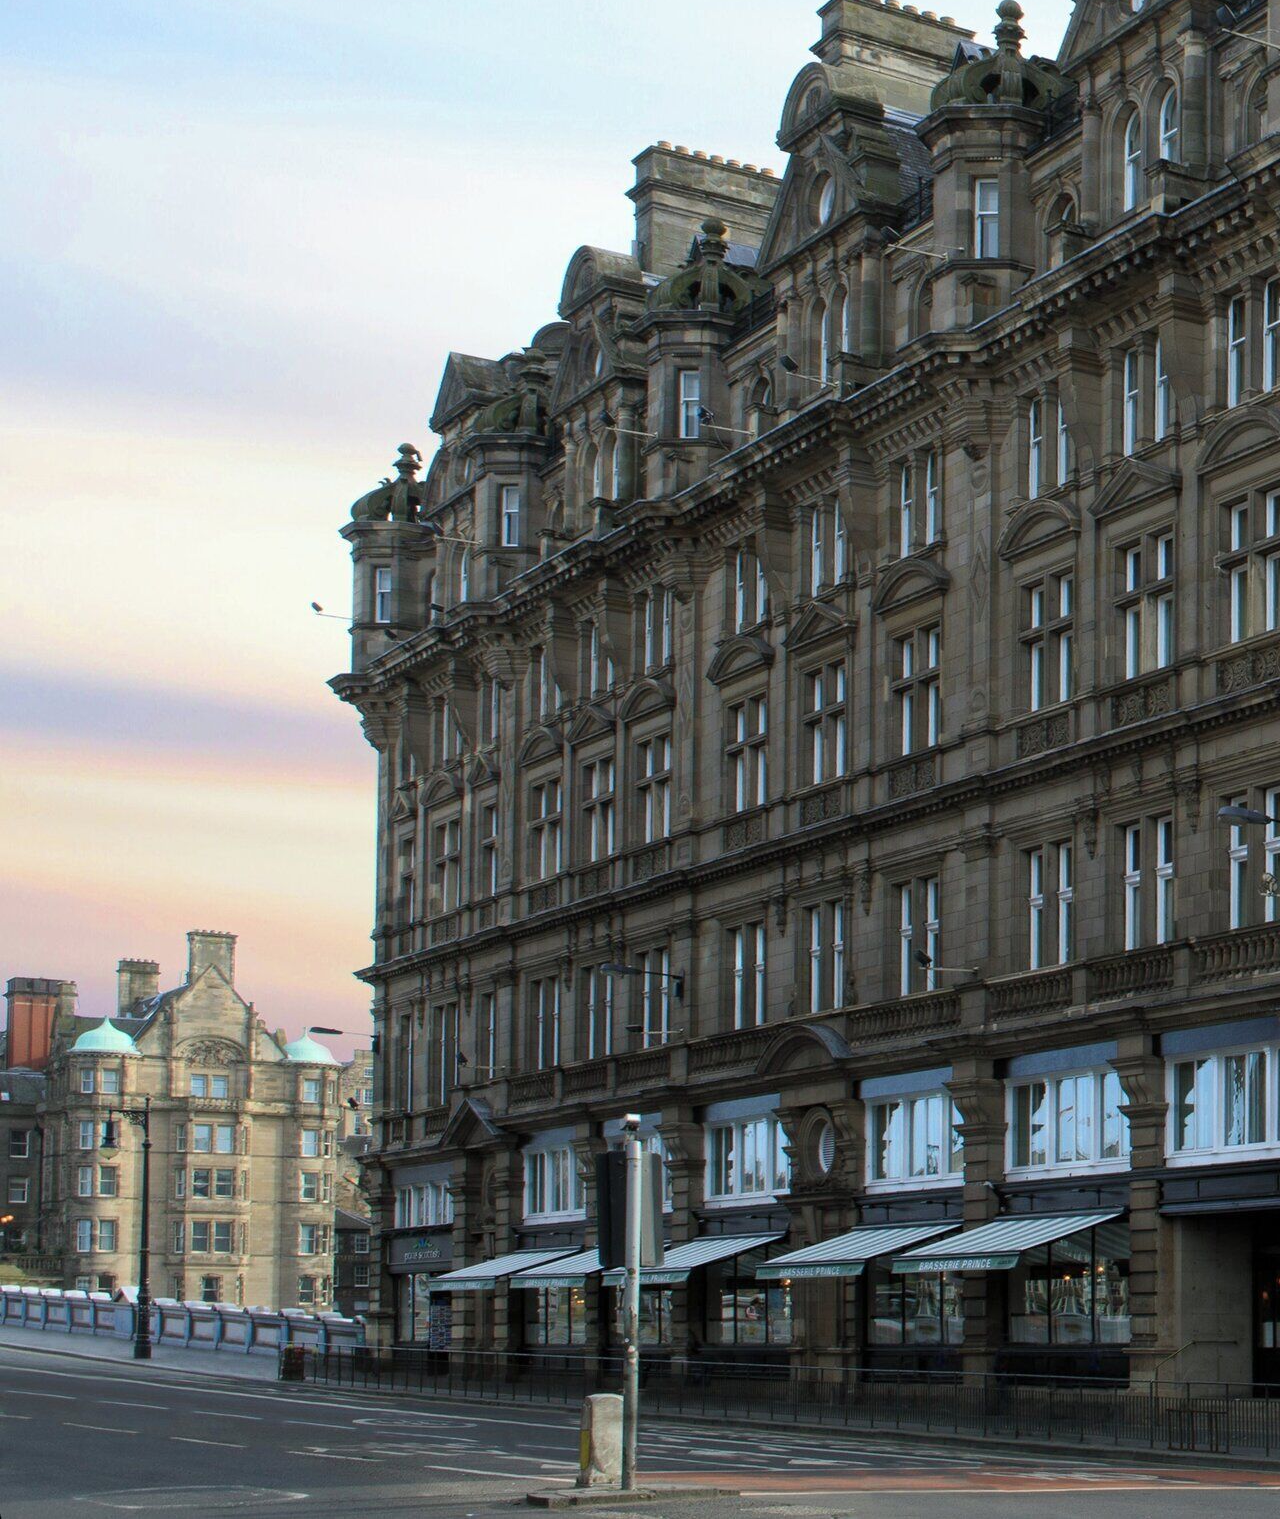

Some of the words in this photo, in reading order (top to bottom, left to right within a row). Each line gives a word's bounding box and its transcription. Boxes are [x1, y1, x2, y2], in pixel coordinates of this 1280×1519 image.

[919, 1260, 960, 1271] BRASSERIE
[961, 1259, 991, 1269] PRINCE
[779, 1268, 813, 1277] BRASSERIE
[815, 1266, 840, 1275] PRINCE
